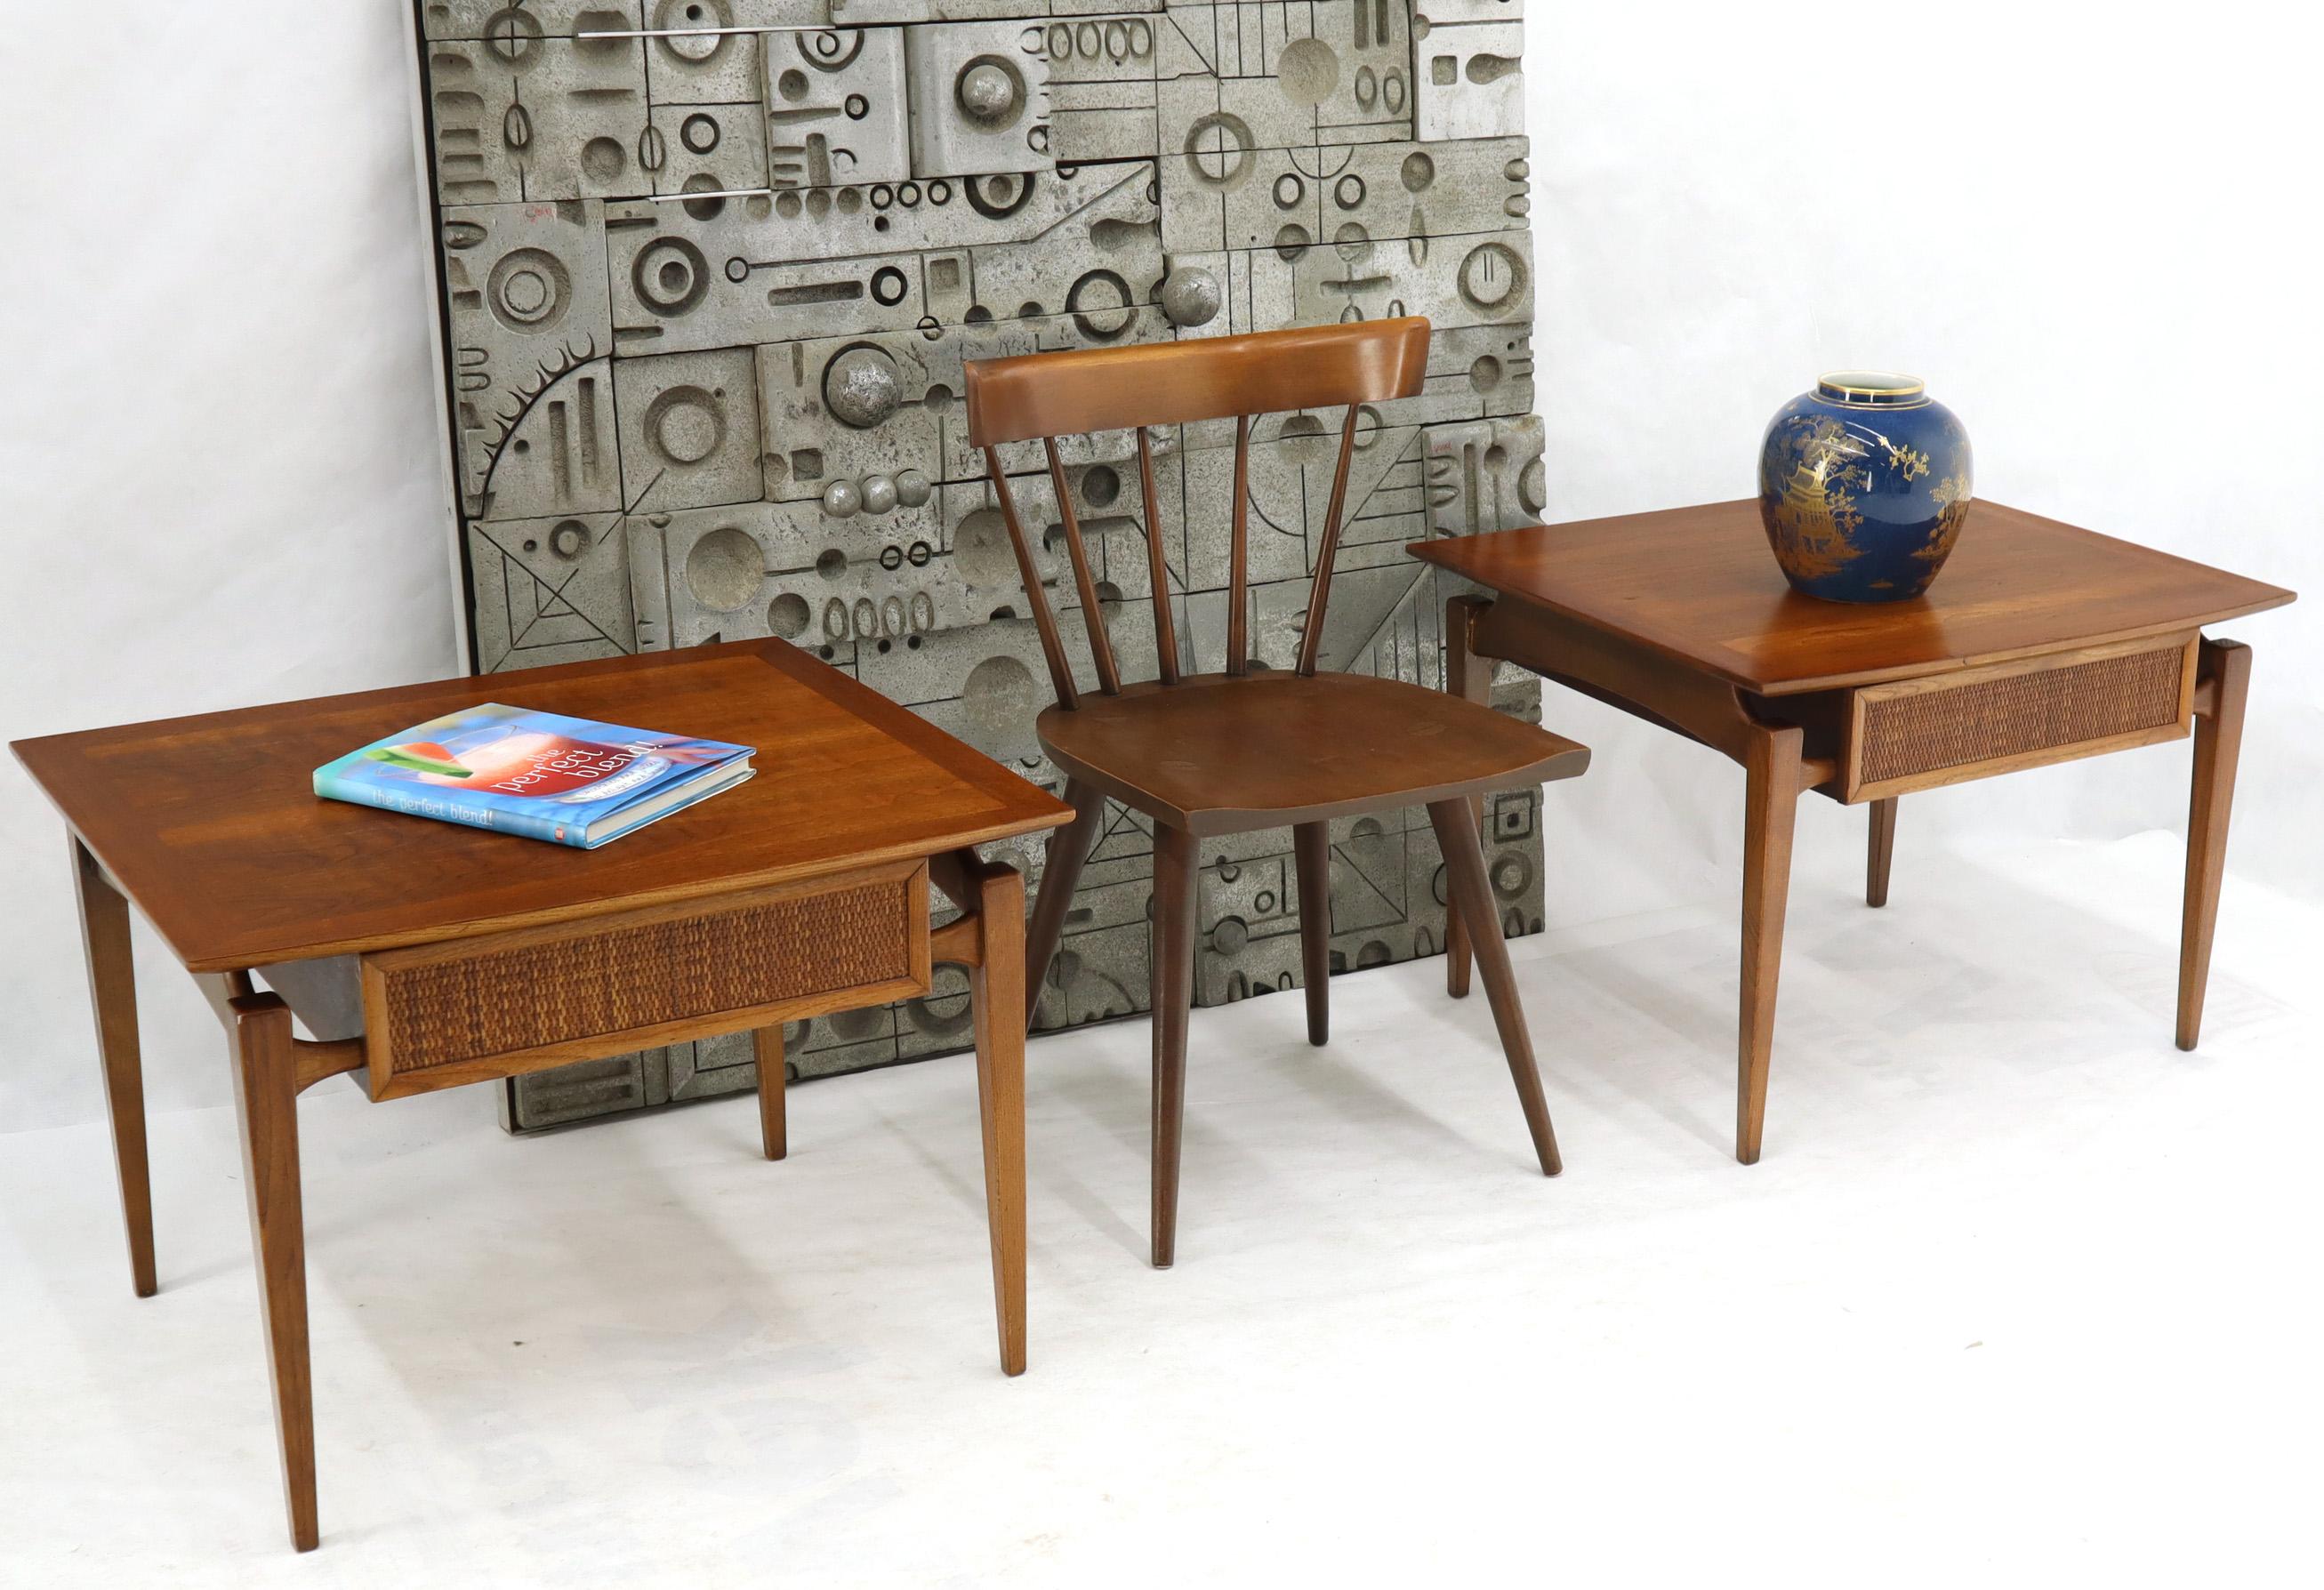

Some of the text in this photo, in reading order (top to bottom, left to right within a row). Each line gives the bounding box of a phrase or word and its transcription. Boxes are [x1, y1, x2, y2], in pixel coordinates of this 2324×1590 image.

[489, 749, 604, 793] perfect
[526, 748, 566, 763] the
[563, 740, 663, 779] blend!
[373, 789, 494, 826] the perfect blend!
